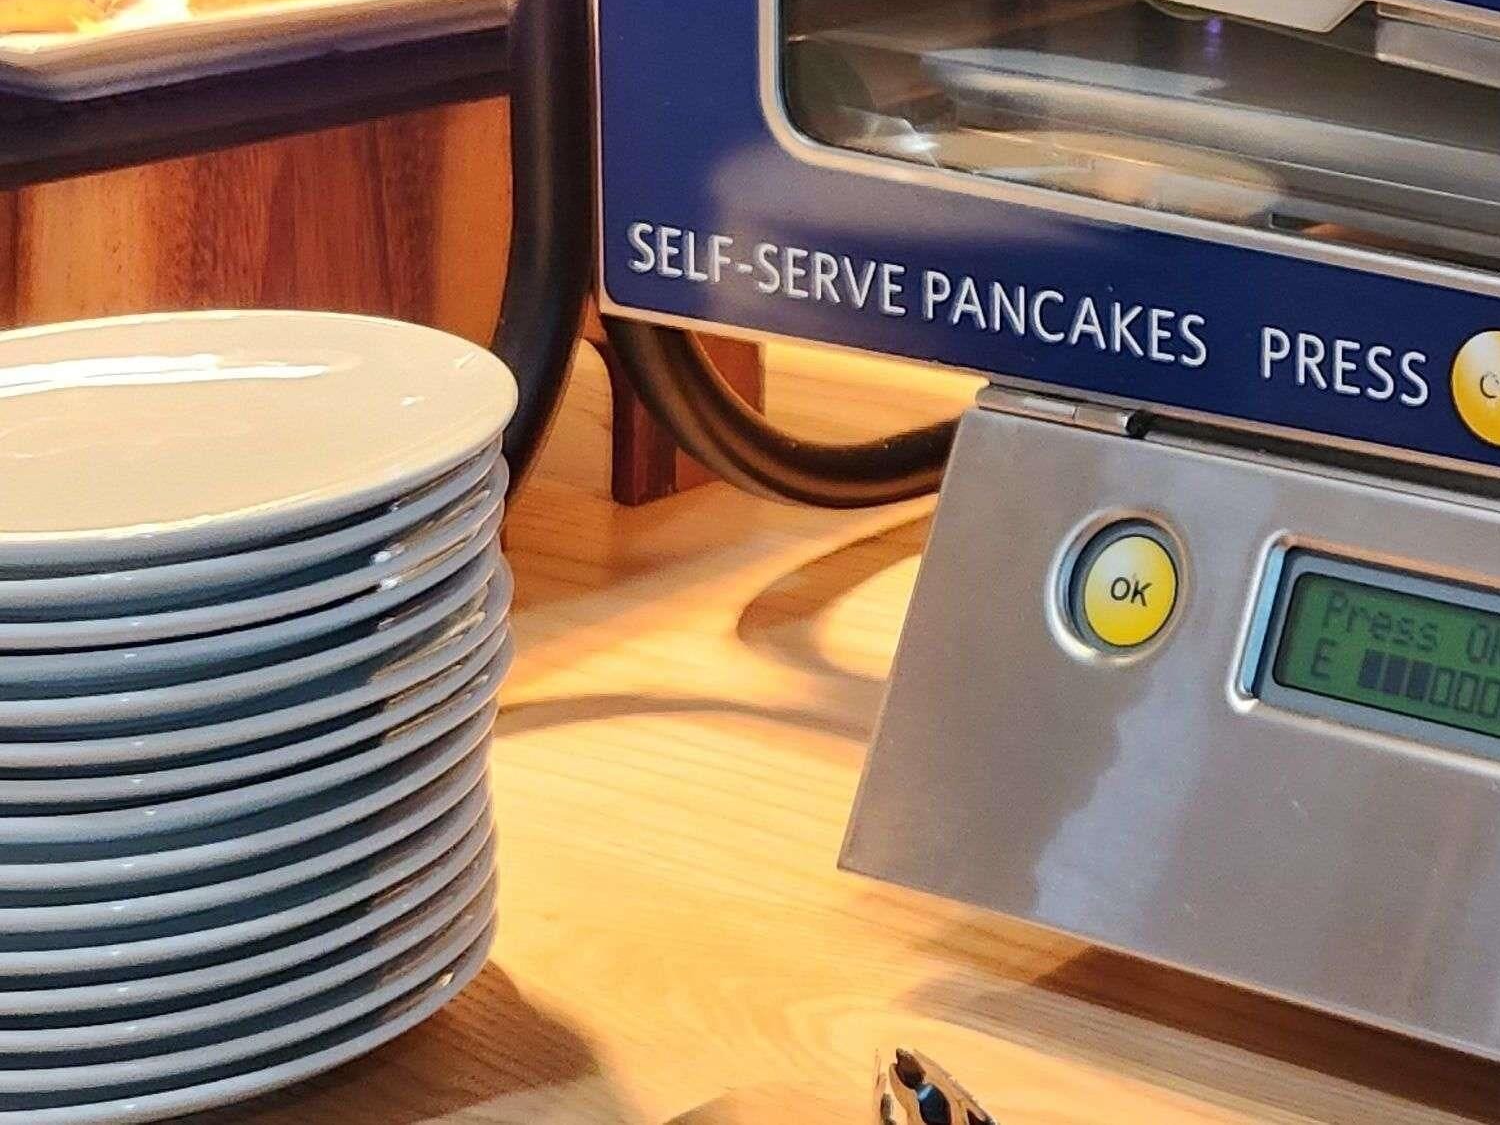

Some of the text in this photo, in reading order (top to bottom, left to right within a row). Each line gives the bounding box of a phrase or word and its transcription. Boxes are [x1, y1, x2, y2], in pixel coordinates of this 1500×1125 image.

[628, 221, 1208, 369] SELF-SERVE PANCAKES
[1260, 326, 1430, 407] PRESS
[1109, 576, 1153, 607] OK
[1322, 588, 1439, 654] Press
[1309, 638, 1335, 681] E
